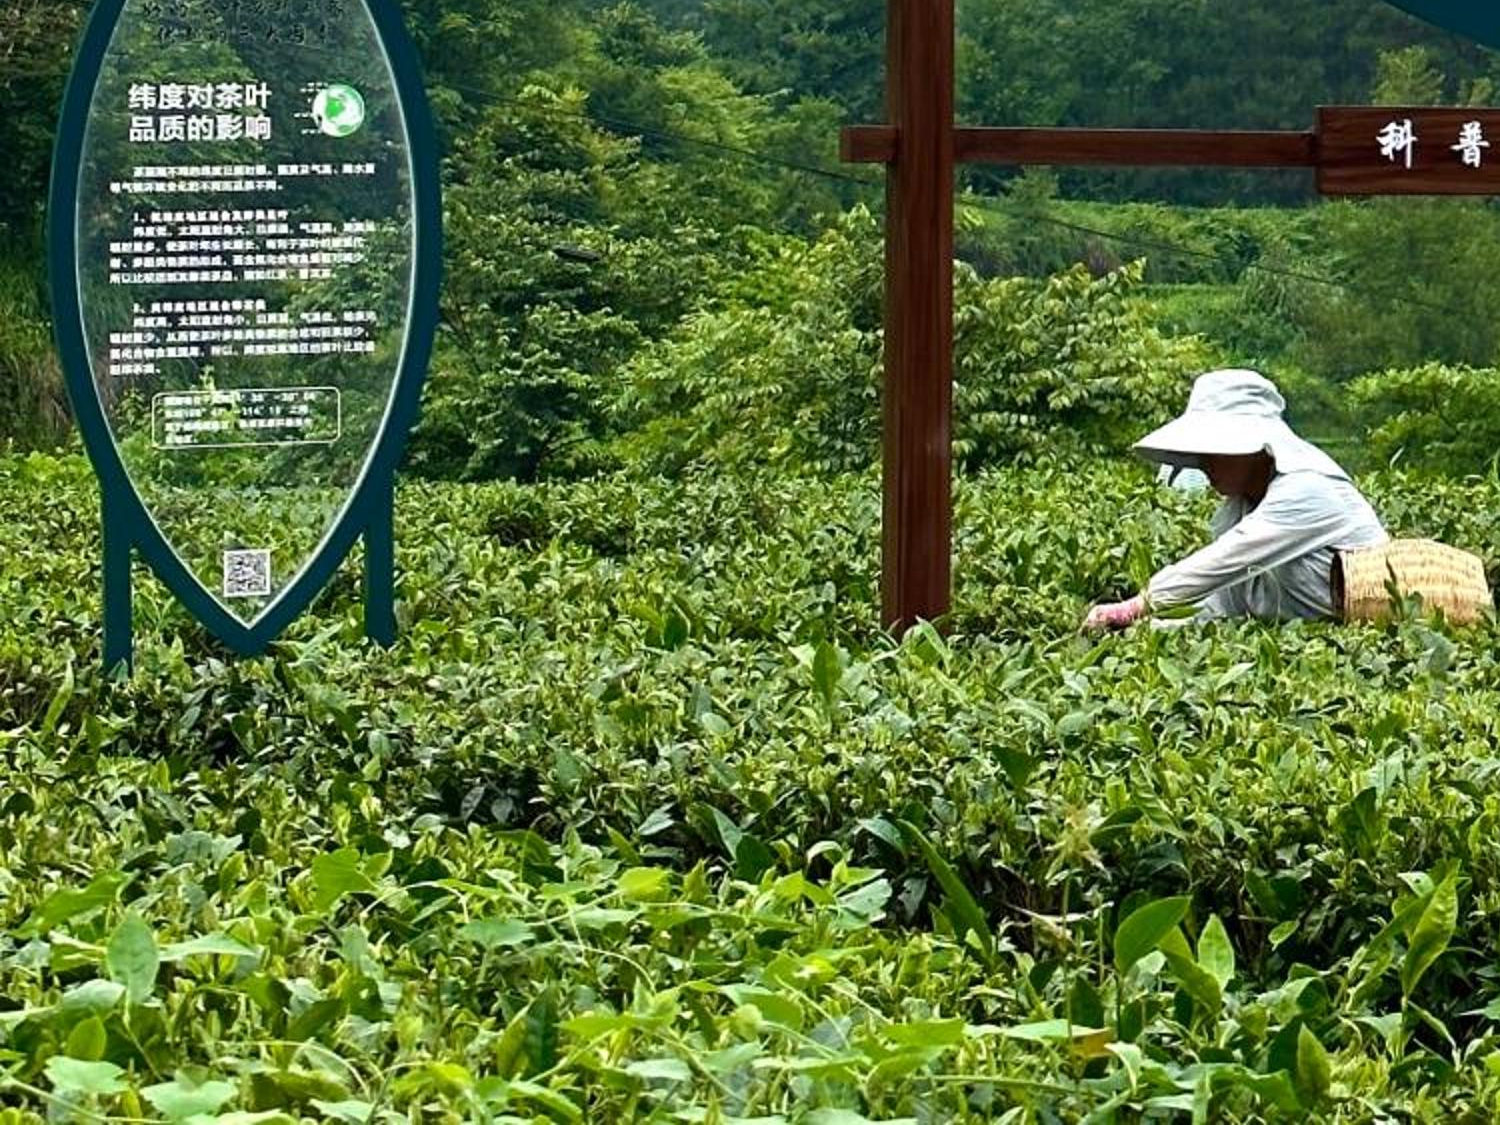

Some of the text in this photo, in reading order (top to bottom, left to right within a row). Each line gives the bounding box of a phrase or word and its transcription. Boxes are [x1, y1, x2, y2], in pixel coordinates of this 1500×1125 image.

[128, 82, 272, 110] 纬度对茶叶
[129, 114, 271, 142] 品质的影响
